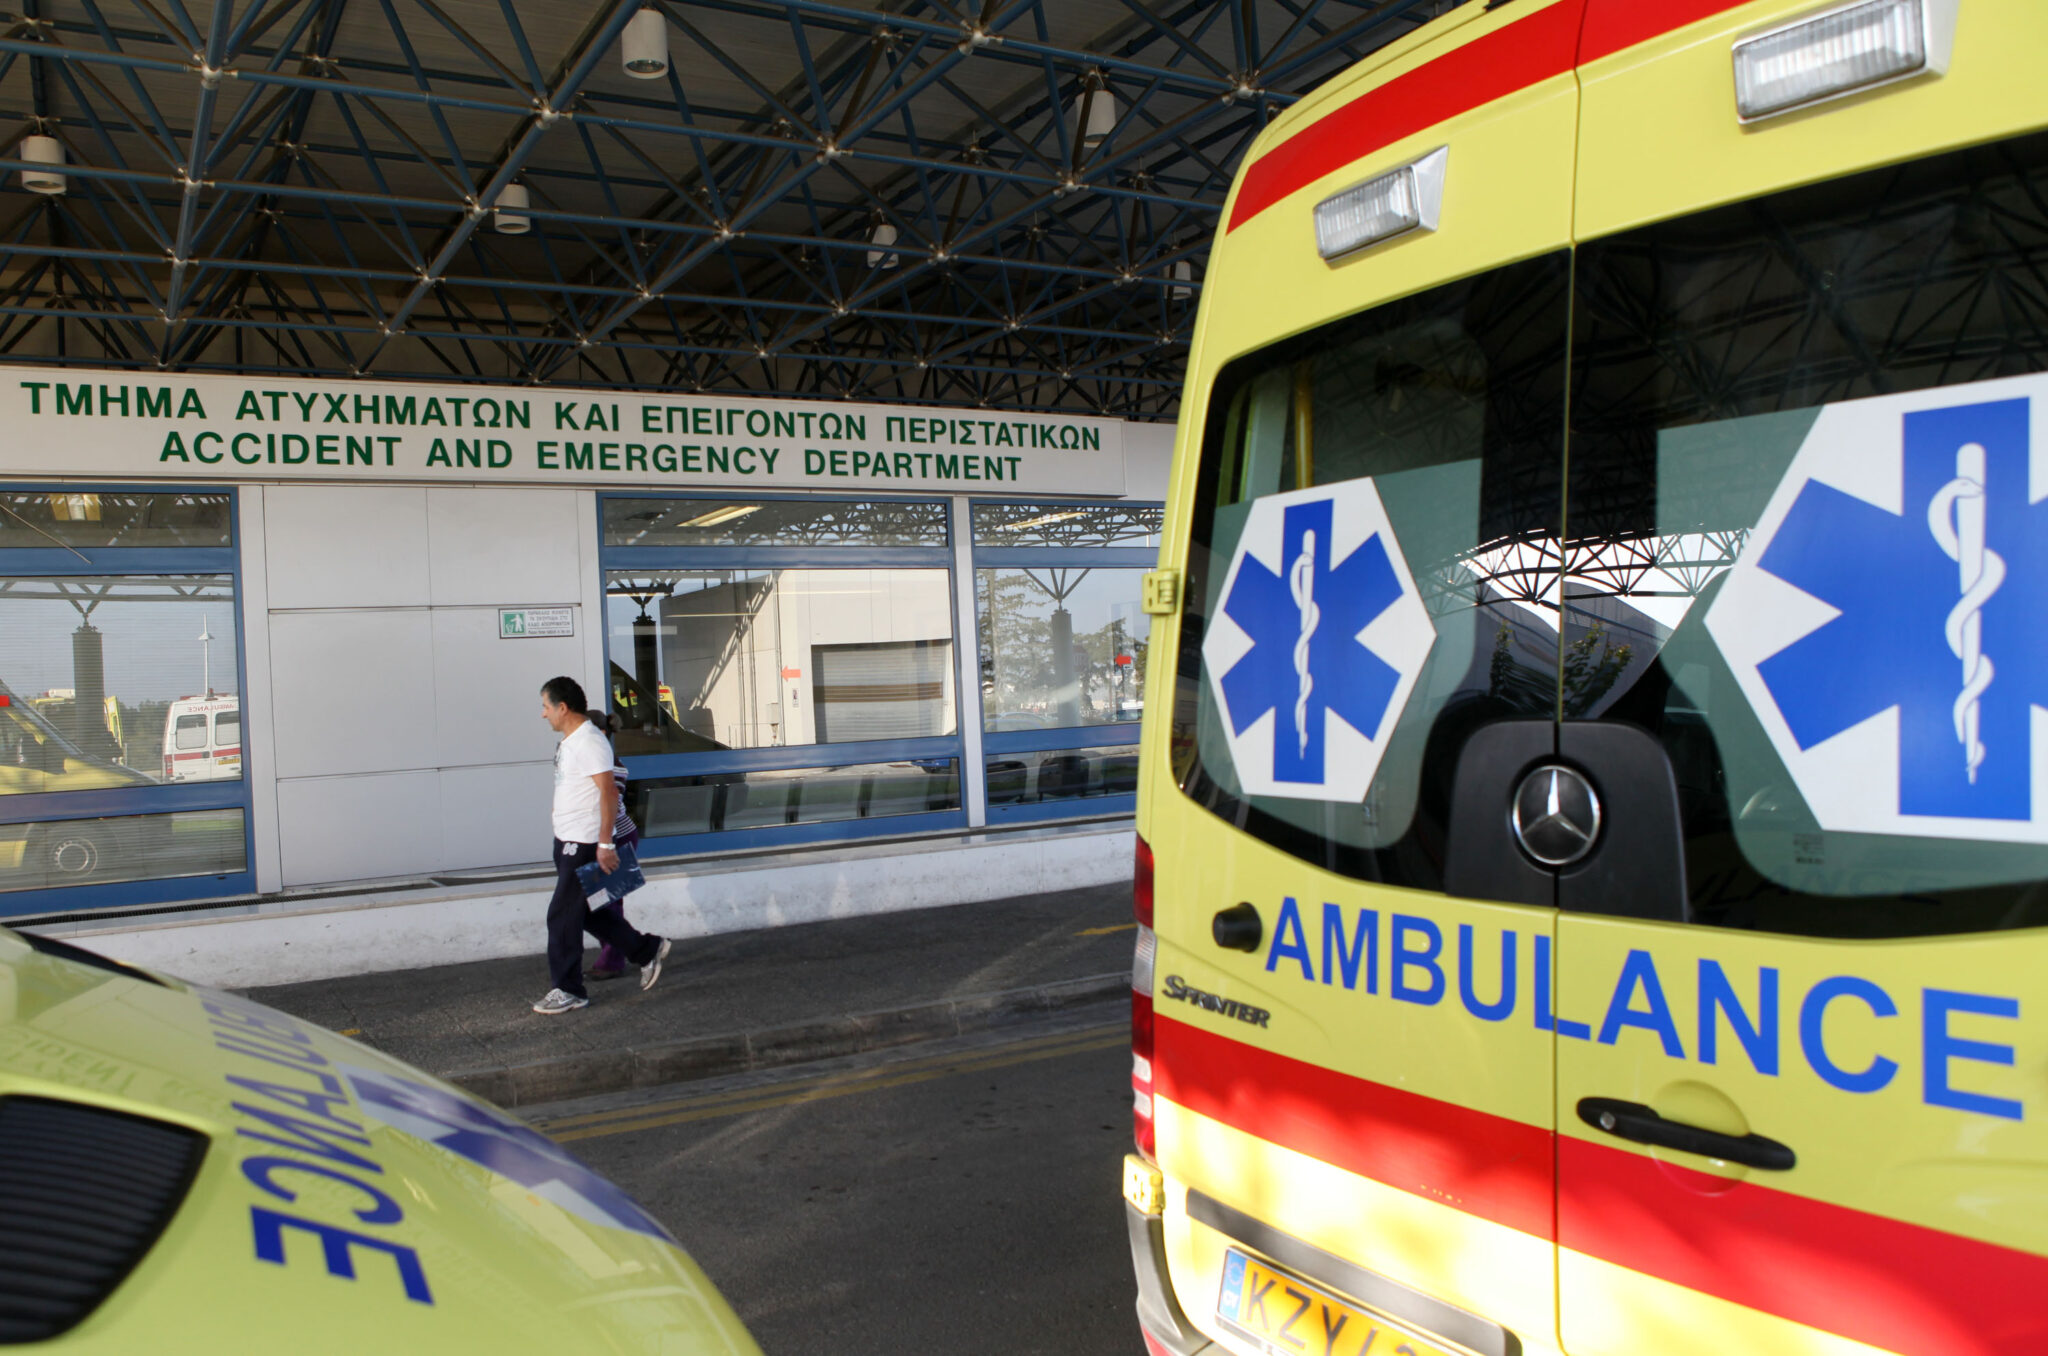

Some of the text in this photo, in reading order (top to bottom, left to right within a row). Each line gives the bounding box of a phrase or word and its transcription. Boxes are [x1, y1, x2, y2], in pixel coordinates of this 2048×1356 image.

[20, 381, 1100, 450] ΤΜΗΜΑ ΑΤΥΧΗΜΑΤΩΝ ΚΑΙ ΕΠΕΙΓΟΝΤΩΝ ΠΕΡΙΣΤΑΤΙΚΩΝ
[159, 431, 1022, 481] ACCIDENT AND EMERGENCY DEPARTMENT
[1265, 896, 2024, 1120] AMBULANCE
